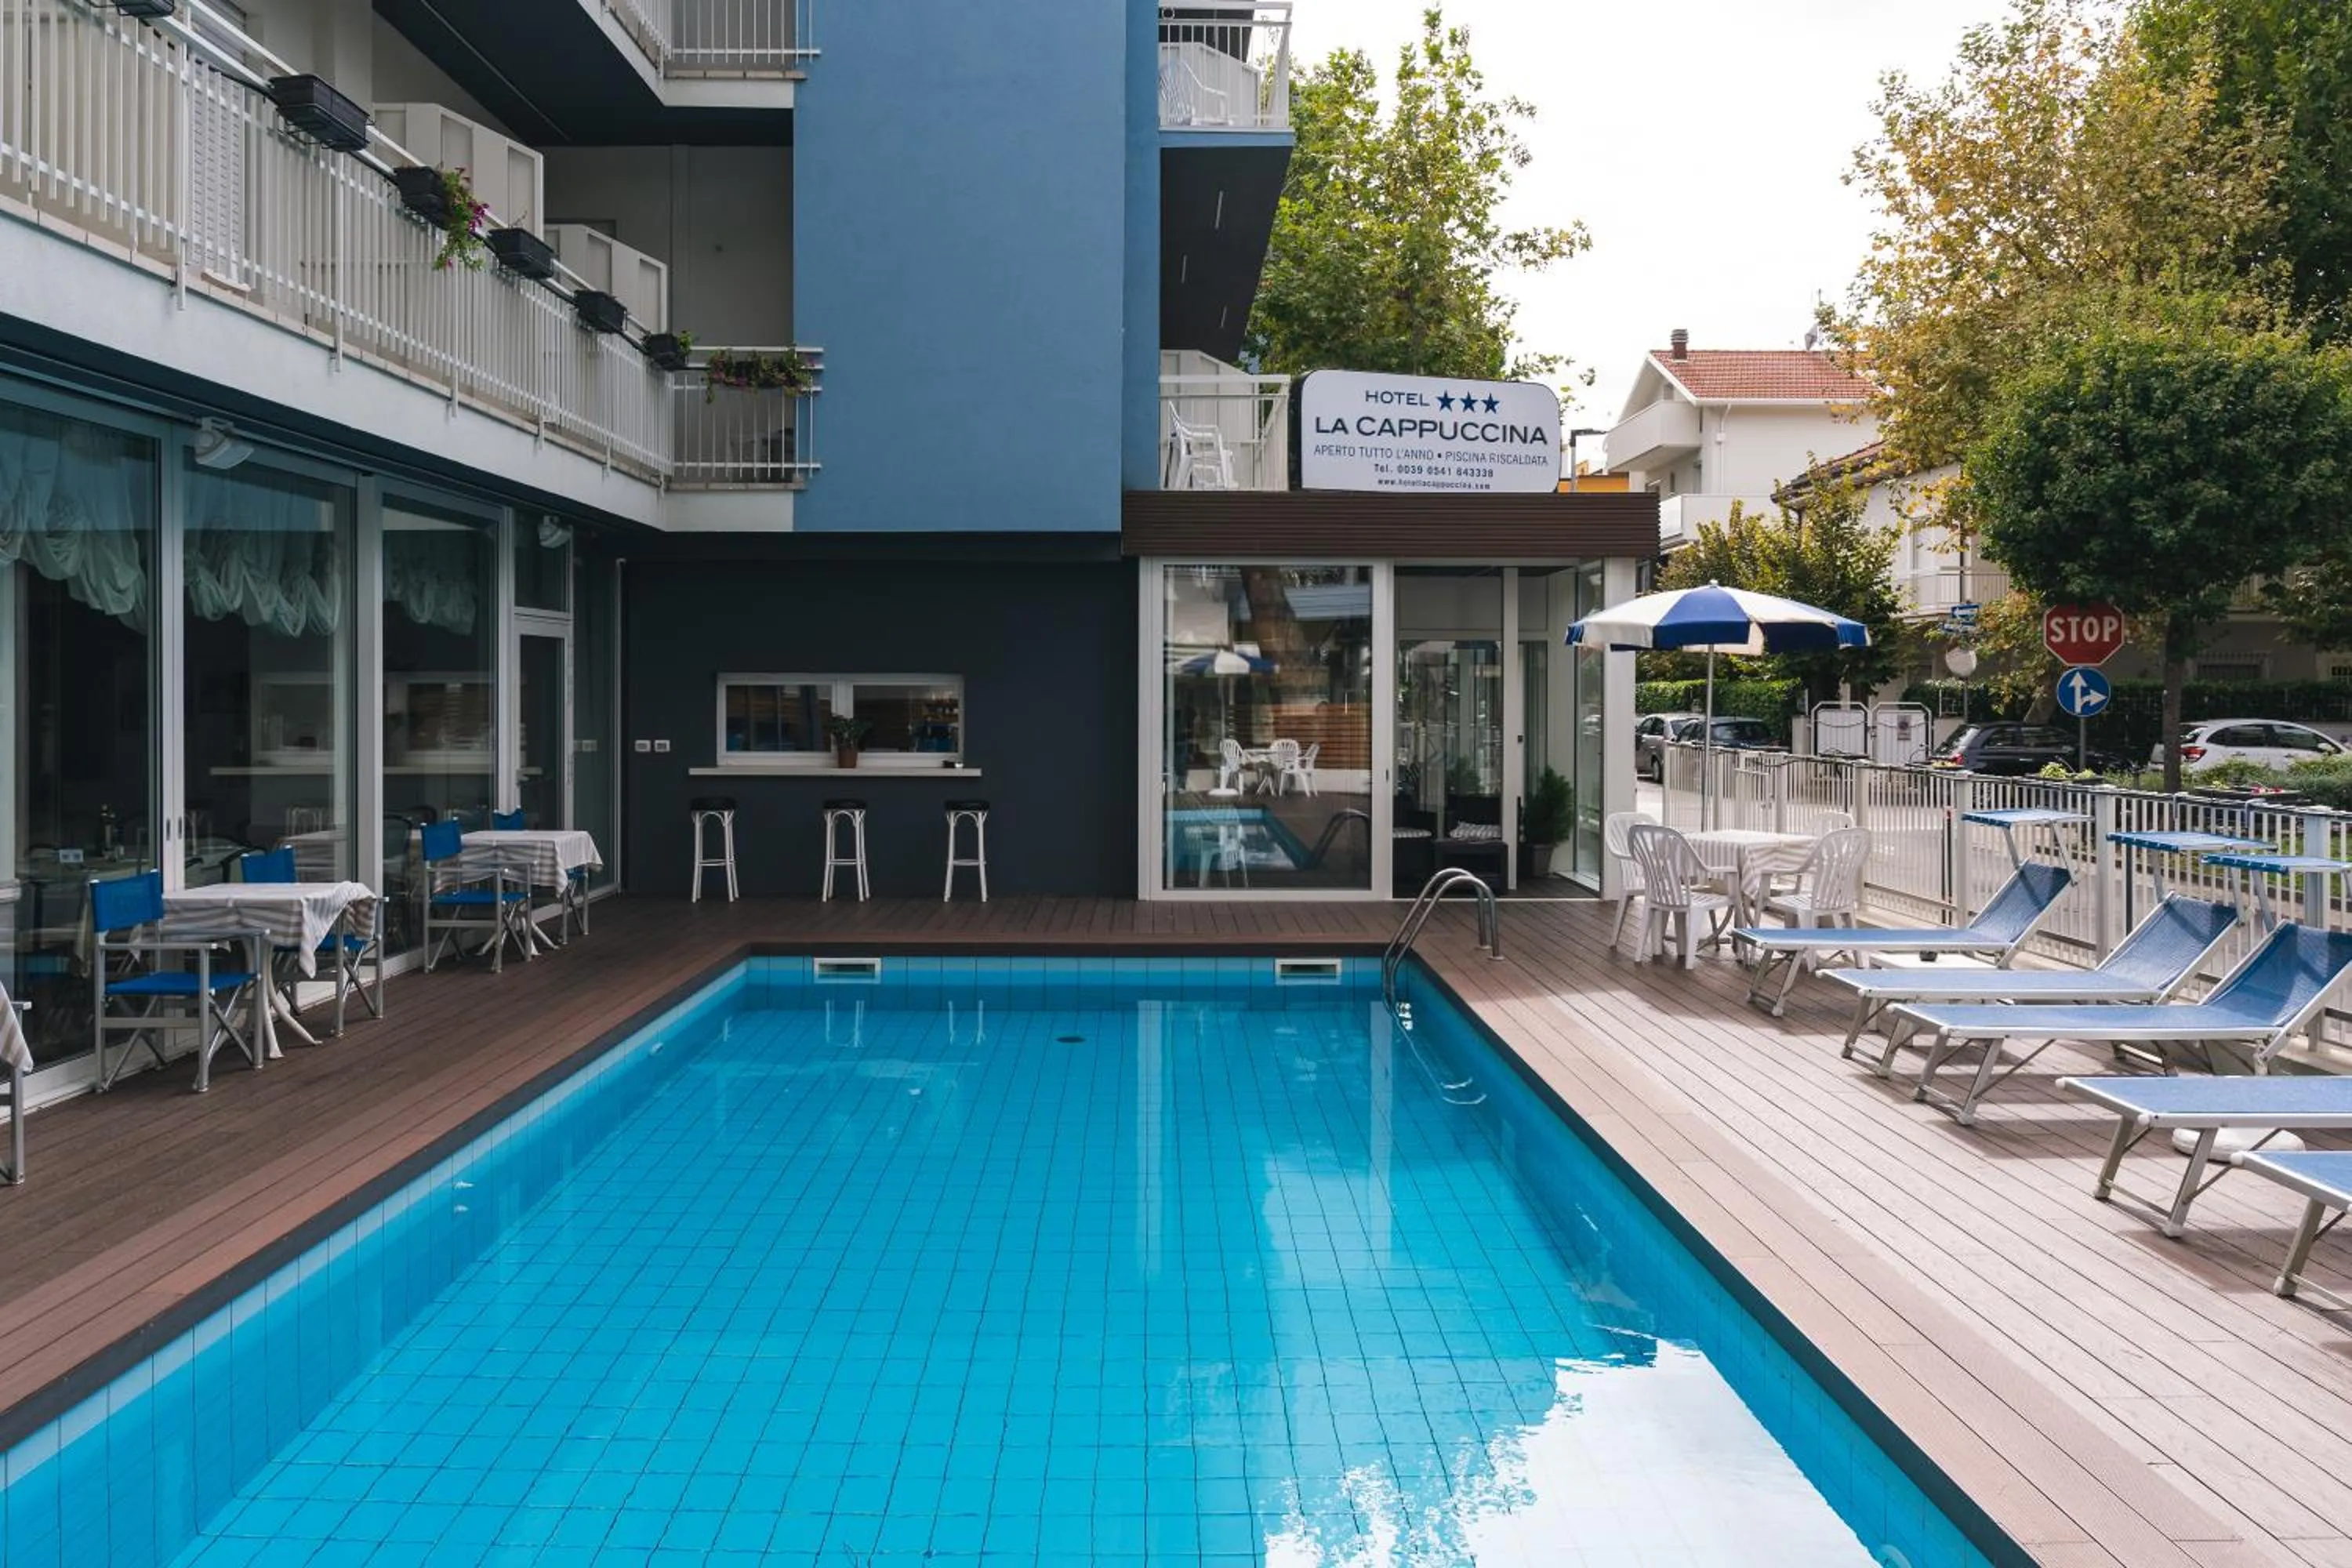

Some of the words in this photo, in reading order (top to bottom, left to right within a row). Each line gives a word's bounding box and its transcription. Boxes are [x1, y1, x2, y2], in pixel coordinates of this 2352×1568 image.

[1365, 390, 1430, 406] HOTEL
[1316, 416, 1348, 434] LA
[1356, 416, 1548, 445] CAPPUCCINA
[1314, 445, 1356, 457] APERTO
[1359, 446, 1392, 459] TUTTO
[1396, 449, 1434, 460] L'ANNO
[1445, 451, 1486, 463] PISCINA
[1490, 452, 1548, 466] RISCALDATA
[1374, 463, 1393, 473] Tel.
[1397, 464, 1423, 474] 0039
[1427, 466, 1451, 476] 0541
[1377, 478, 1490, 490] www.htacaccia.m
[2050, 616, 2119, 643] STOP
